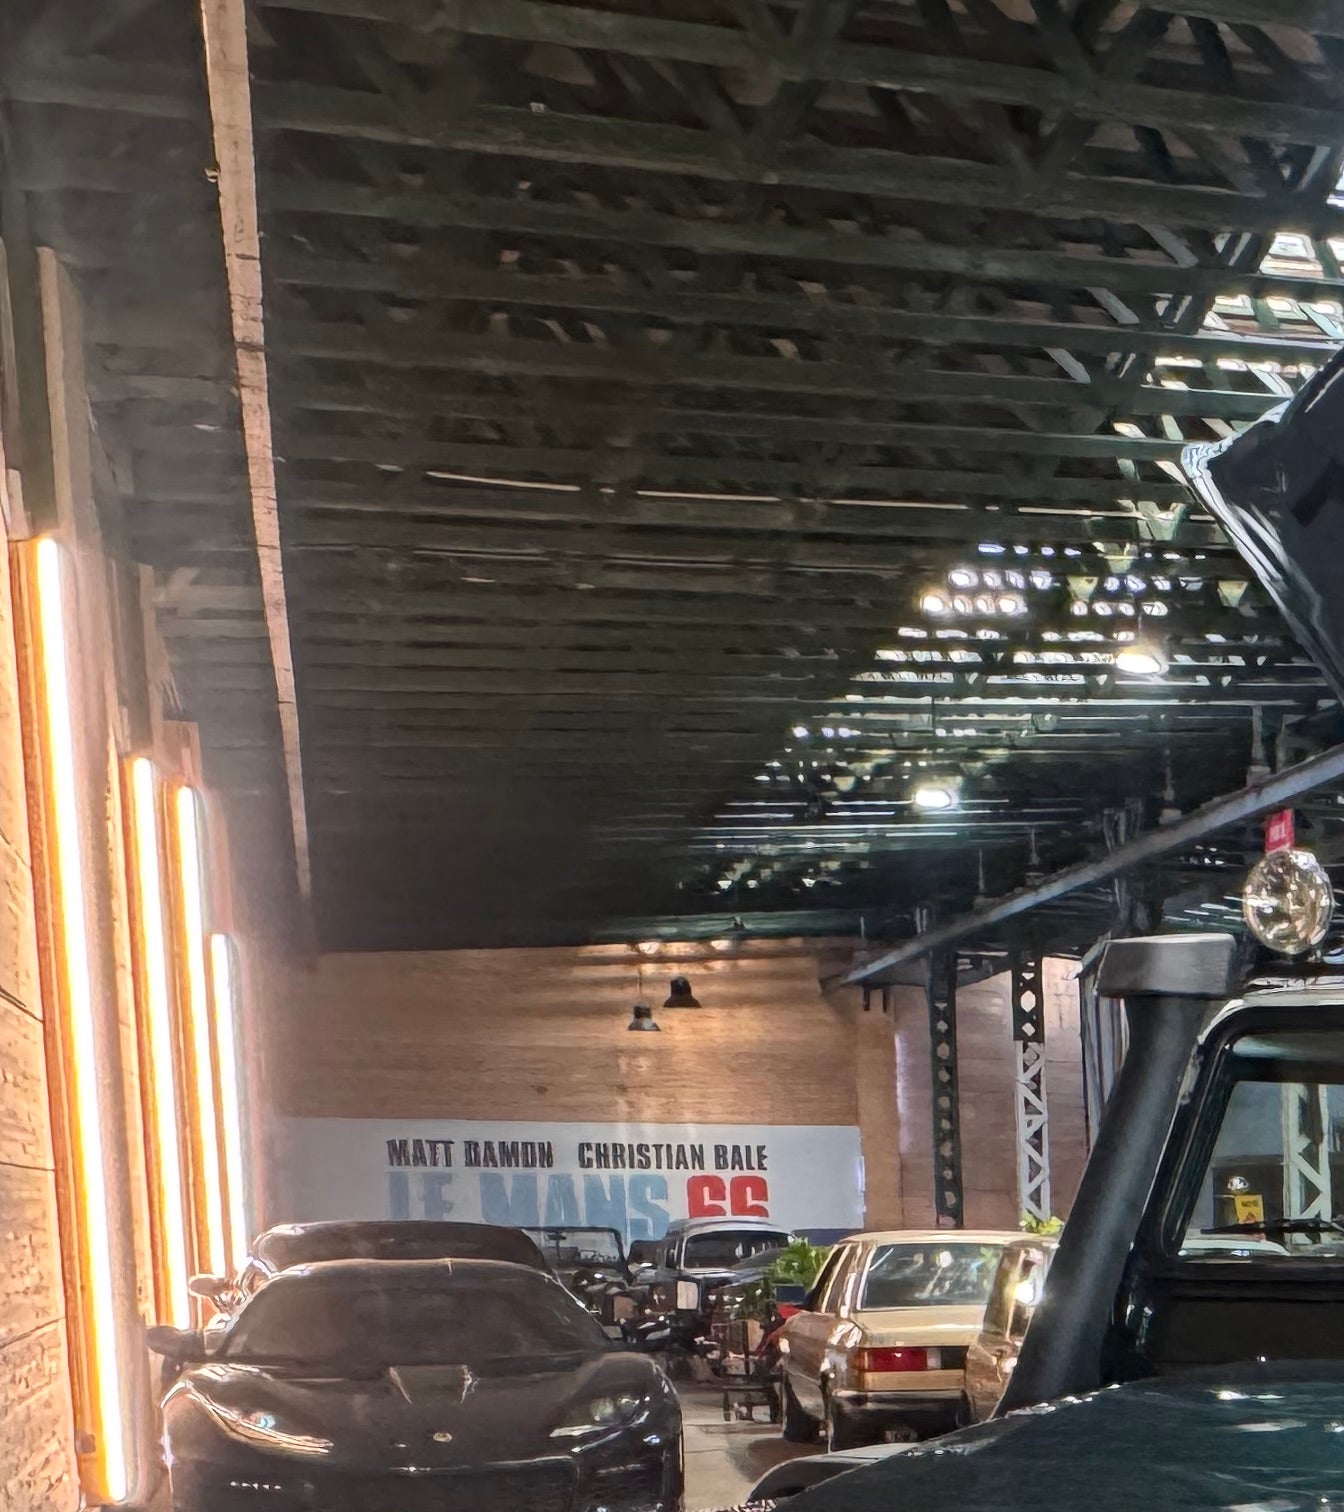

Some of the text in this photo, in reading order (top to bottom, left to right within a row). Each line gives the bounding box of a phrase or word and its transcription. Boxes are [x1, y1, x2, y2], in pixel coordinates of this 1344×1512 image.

[386, 1139, 769, 1171] MATT DAMON CHRISTIAN BALE
[478, 1172, 671, 1241] MANS
